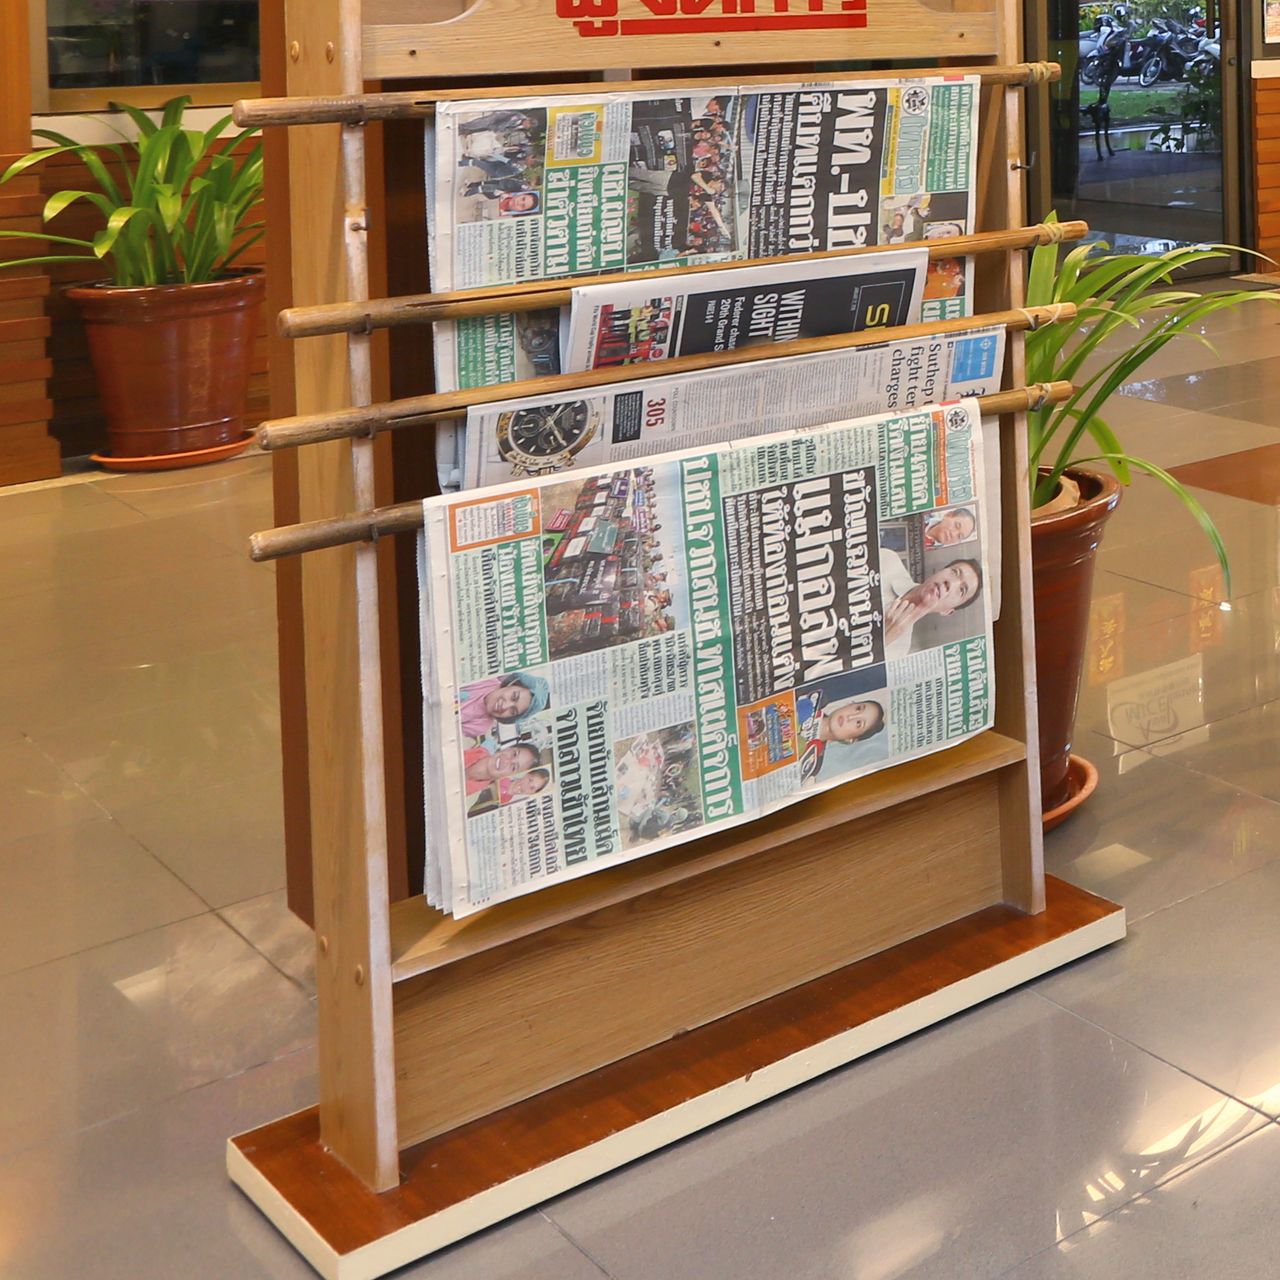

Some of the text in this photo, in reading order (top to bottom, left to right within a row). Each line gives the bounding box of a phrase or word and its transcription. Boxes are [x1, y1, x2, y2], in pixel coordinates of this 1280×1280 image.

[826, 90, 876, 251] พท.-ปช
[714, 318, 727, 343] Grand
[718, 297, 731, 319] 20th
[730, 295, 745, 326] Federer
[747, 292, 779, 339] SIGHT
[773, 288, 806, 343] WITHIN
[883, 347, 906, 409] charges
[904, 344, 925, 408] fight ter
[920, 342, 943, 397] Suthep
[645, 397, 666, 428] 305
[791, 474, 851, 682] แม่กอล์ฟ
